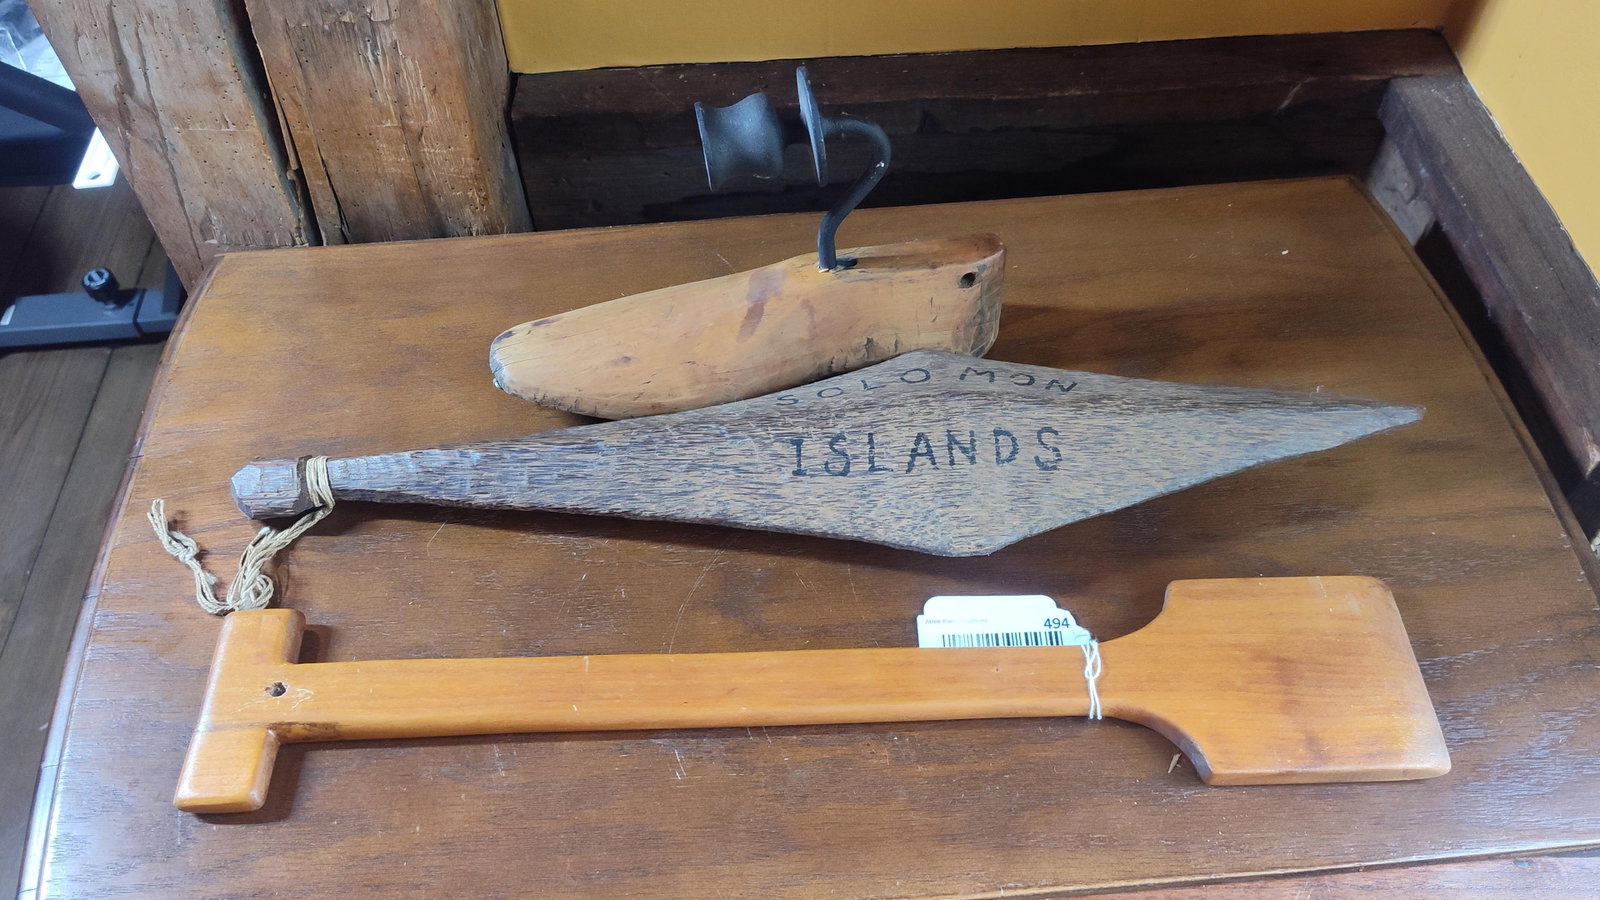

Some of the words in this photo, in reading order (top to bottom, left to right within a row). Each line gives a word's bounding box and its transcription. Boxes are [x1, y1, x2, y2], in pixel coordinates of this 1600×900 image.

[777, 366, 1078, 406] SOLOMON
[790, 427, 1063, 476] ISLANDS
[1043, 617, 1070, 629] 494
